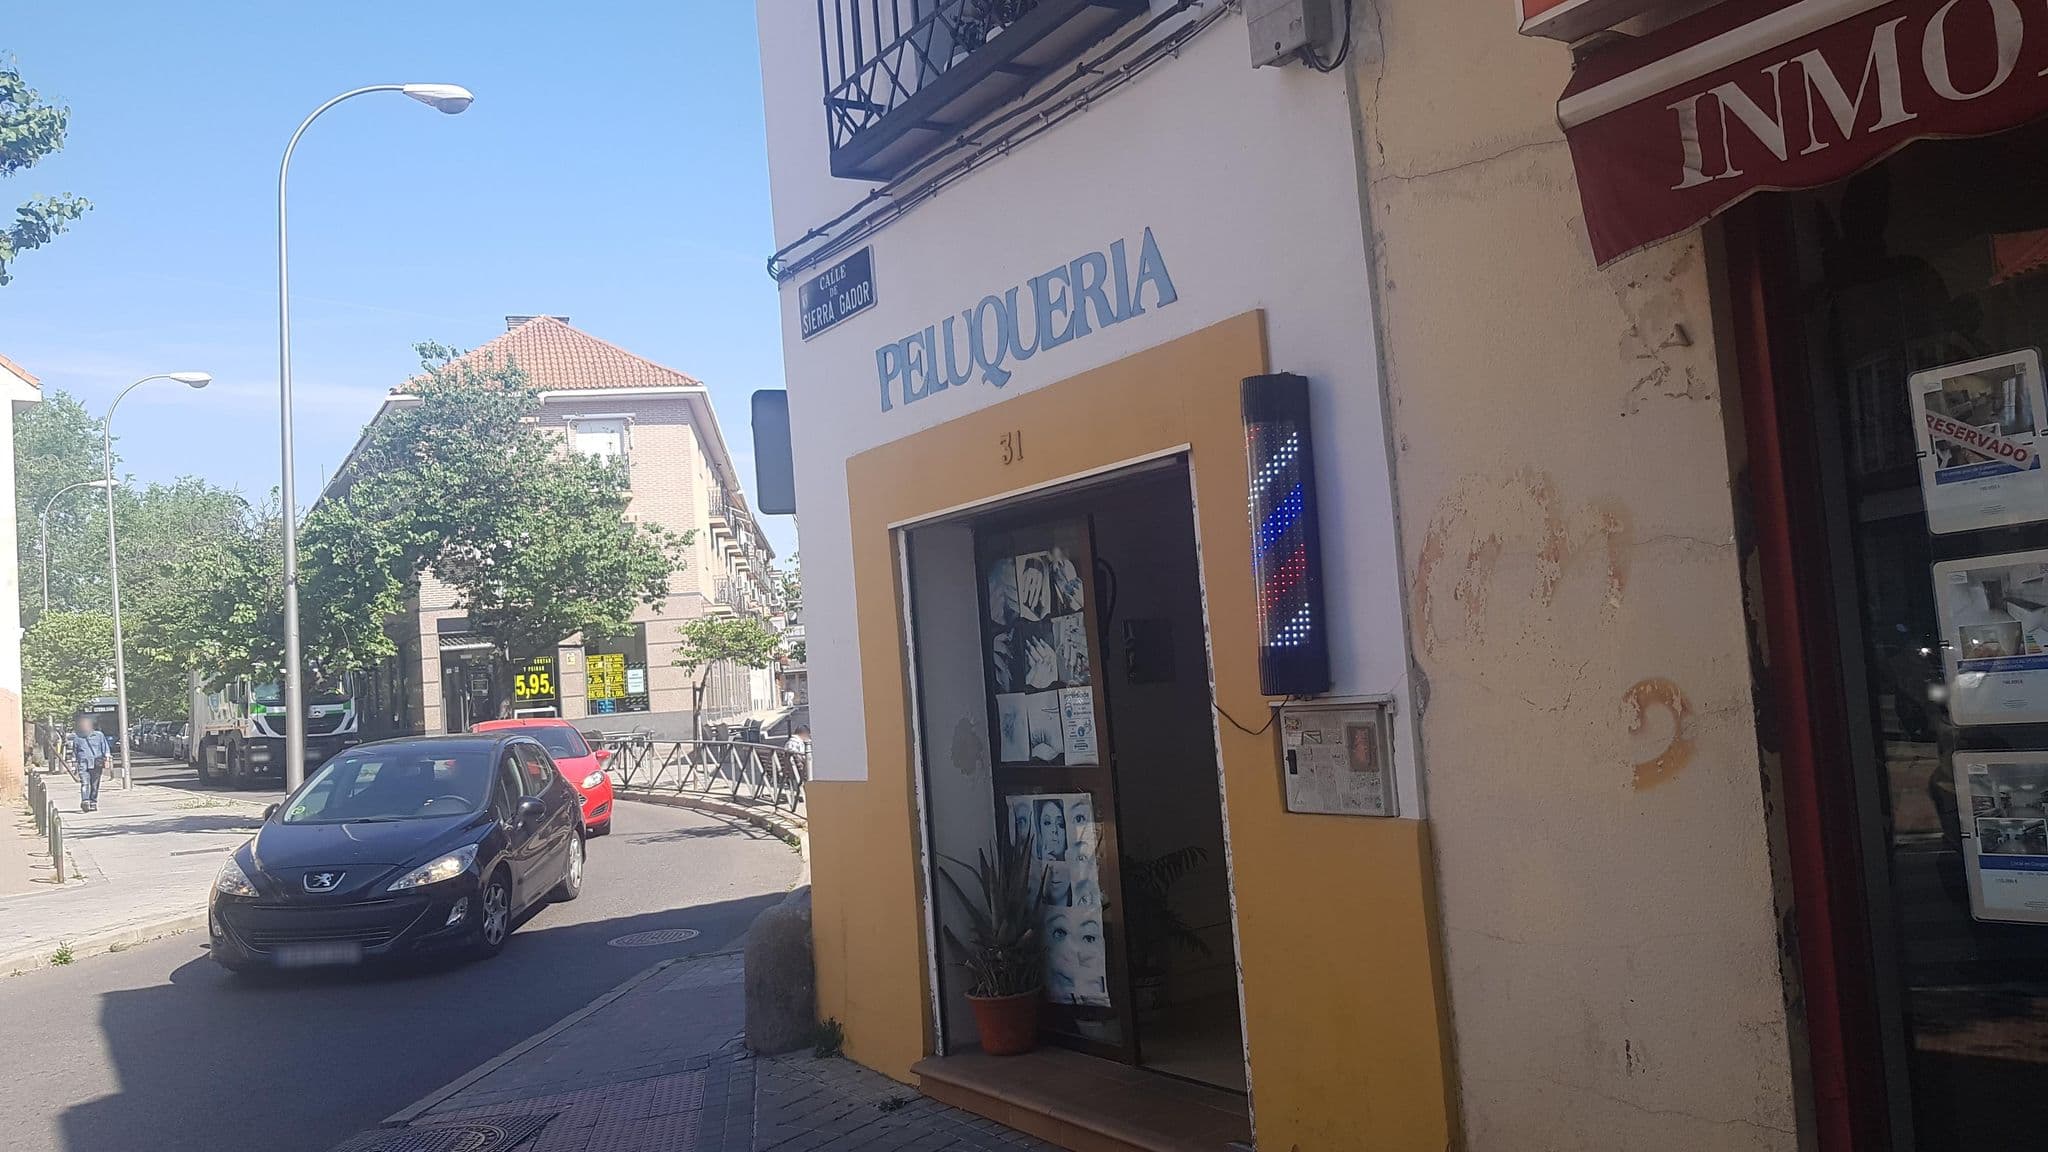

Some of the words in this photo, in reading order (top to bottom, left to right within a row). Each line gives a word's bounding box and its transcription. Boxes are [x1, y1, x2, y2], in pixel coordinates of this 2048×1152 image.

[1666, 0, 2048, 190] INMO
[819, 264, 847, 290] CALLE
[829, 285, 838, 297] DE
[803, 300, 835, 334] SIERRA
[839, 281, 870, 314] GADOR
[876, 227, 1178, 413] PELUQUERIA
[1000, 429, 1024, 465] 31
[1926, 415, 2028, 462] RESERVADO
